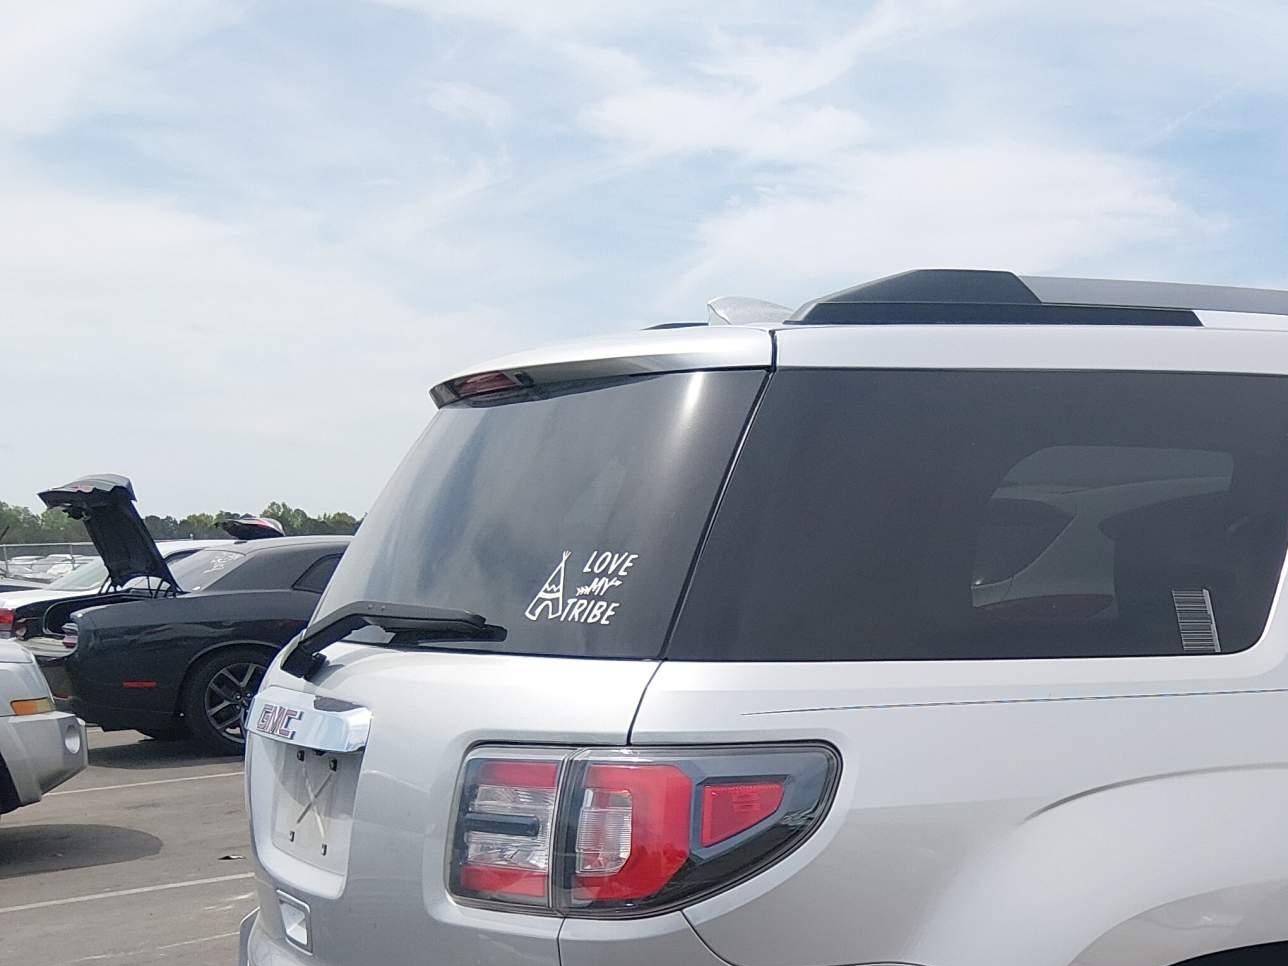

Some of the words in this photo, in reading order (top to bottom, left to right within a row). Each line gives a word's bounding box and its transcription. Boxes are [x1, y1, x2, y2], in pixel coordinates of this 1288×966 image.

[582, 550, 639, 576] LOVE
[560, 598, 620, 625] TRIBE
[256, 703, 303, 740] GMC
